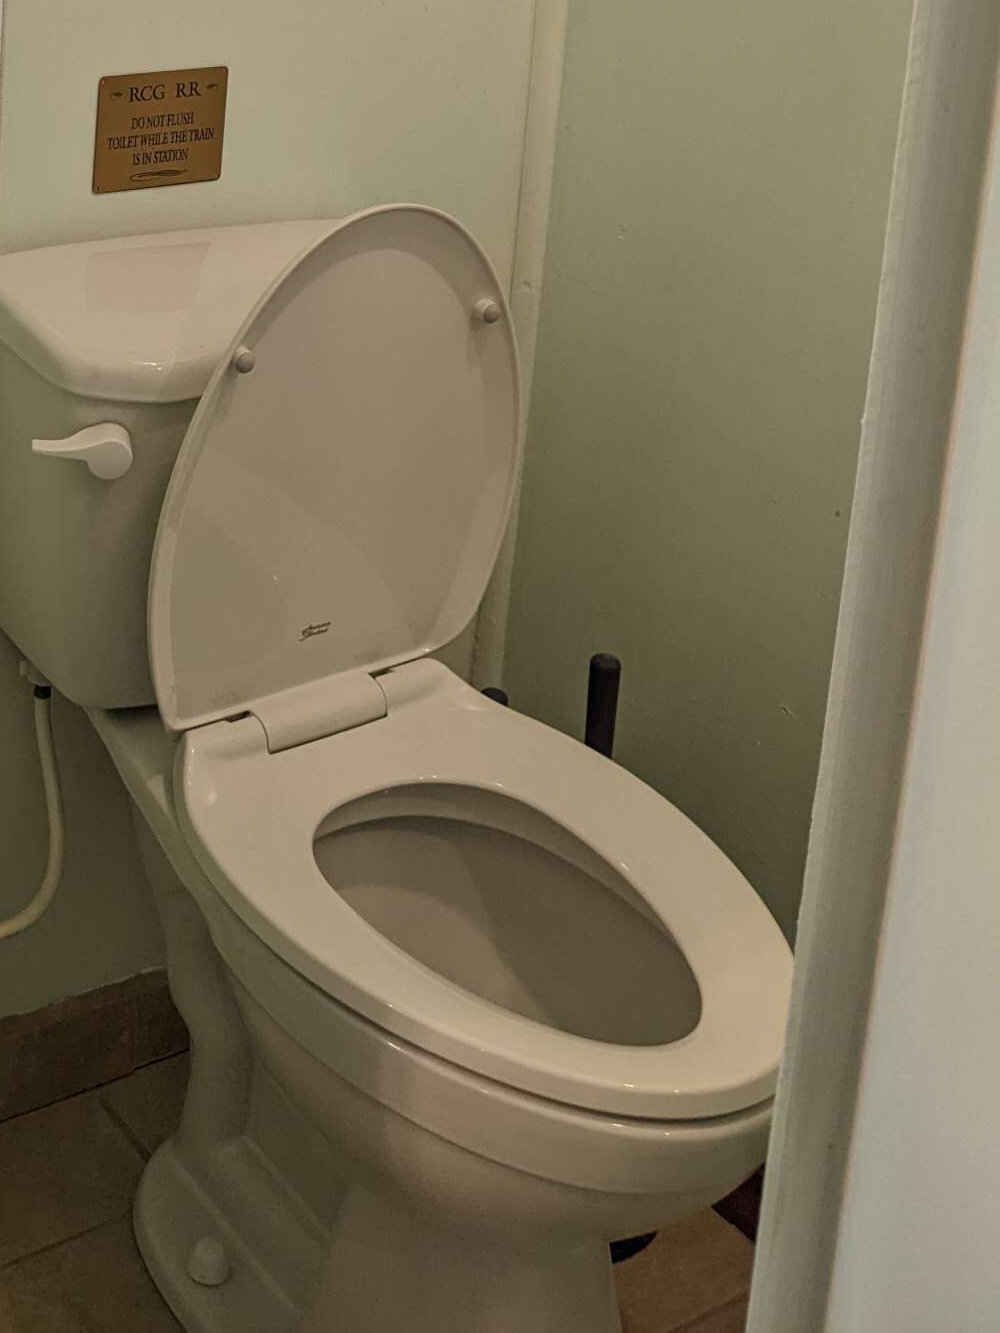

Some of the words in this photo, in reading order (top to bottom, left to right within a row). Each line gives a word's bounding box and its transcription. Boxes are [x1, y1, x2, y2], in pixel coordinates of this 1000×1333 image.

[128, 84, 168, 103] RCG
[175, 81, 202, 98] RR
[131, 116, 146, 130] DO
[147, 113, 167, 128] NOT
[167, 111, 195, 126] FLUSH
[107, 135, 139, 151] TOILET
[140, 131, 169, 147] WHILE
[170, 129, 189, 144] THE
[189, 126, 215, 142] TRAIN
[132, 152, 142, 166] IS
[142, 151, 153, 165] IN
[153, 147, 190, 163] STATION
